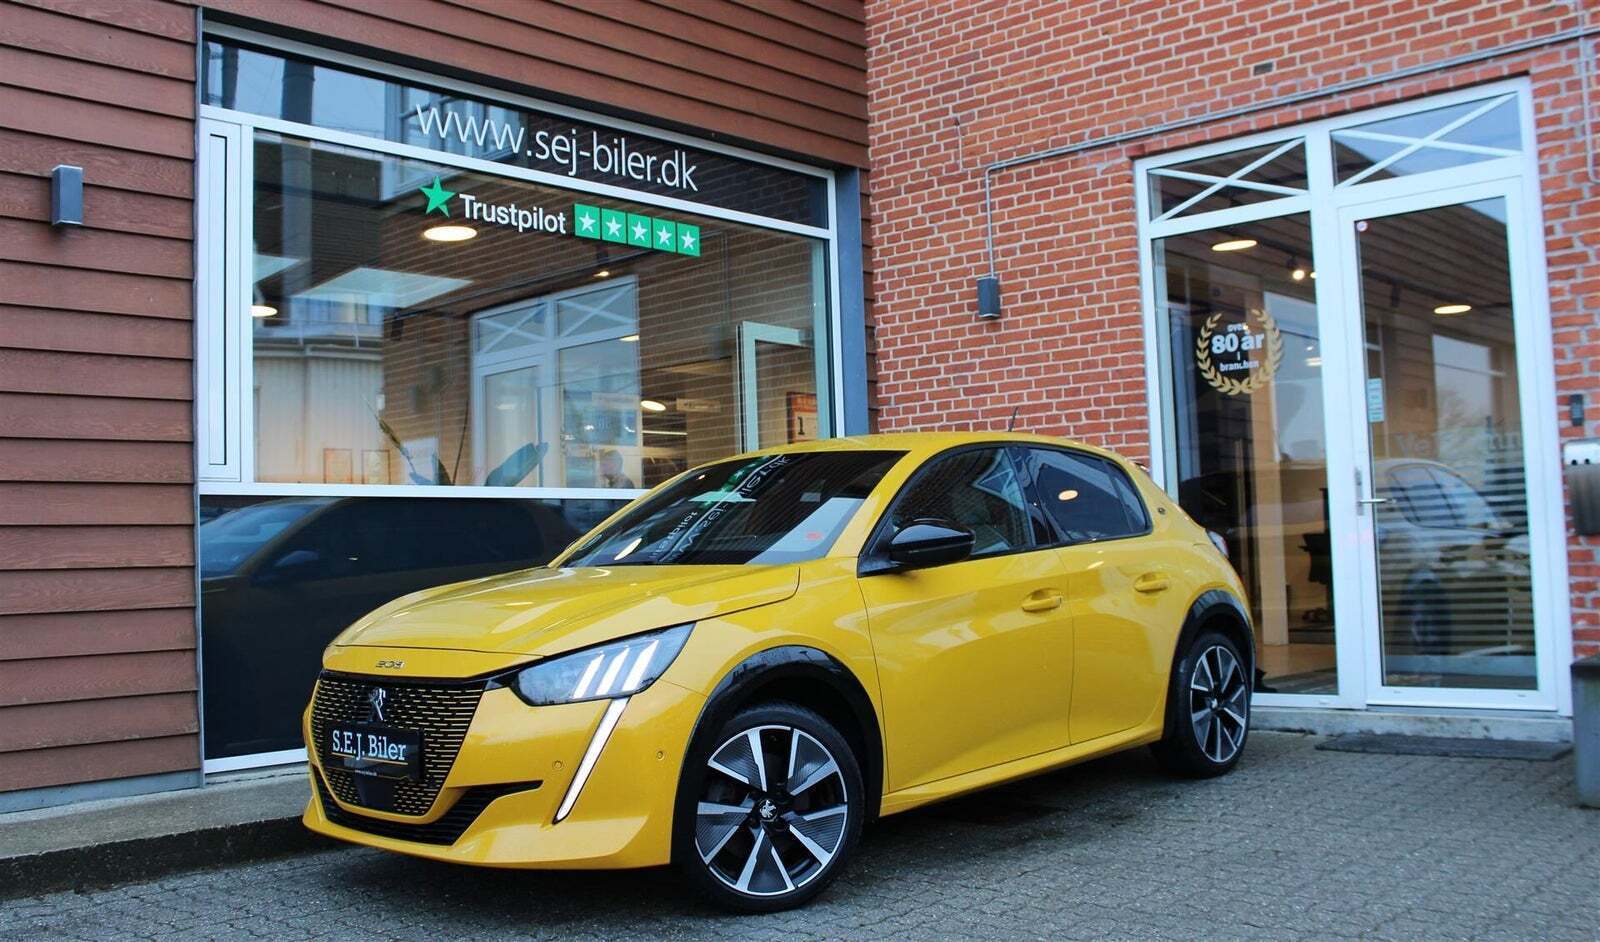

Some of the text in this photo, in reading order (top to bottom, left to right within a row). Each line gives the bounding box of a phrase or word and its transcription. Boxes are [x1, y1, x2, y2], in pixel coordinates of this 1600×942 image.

[415, 103, 699, 192] www.sej-biler.dk
[458, 193, 567, 235] Trustpilot
[1211, 332, 1239, 355] 80
[332, 729, 407, 761] S.E.J. Biler
